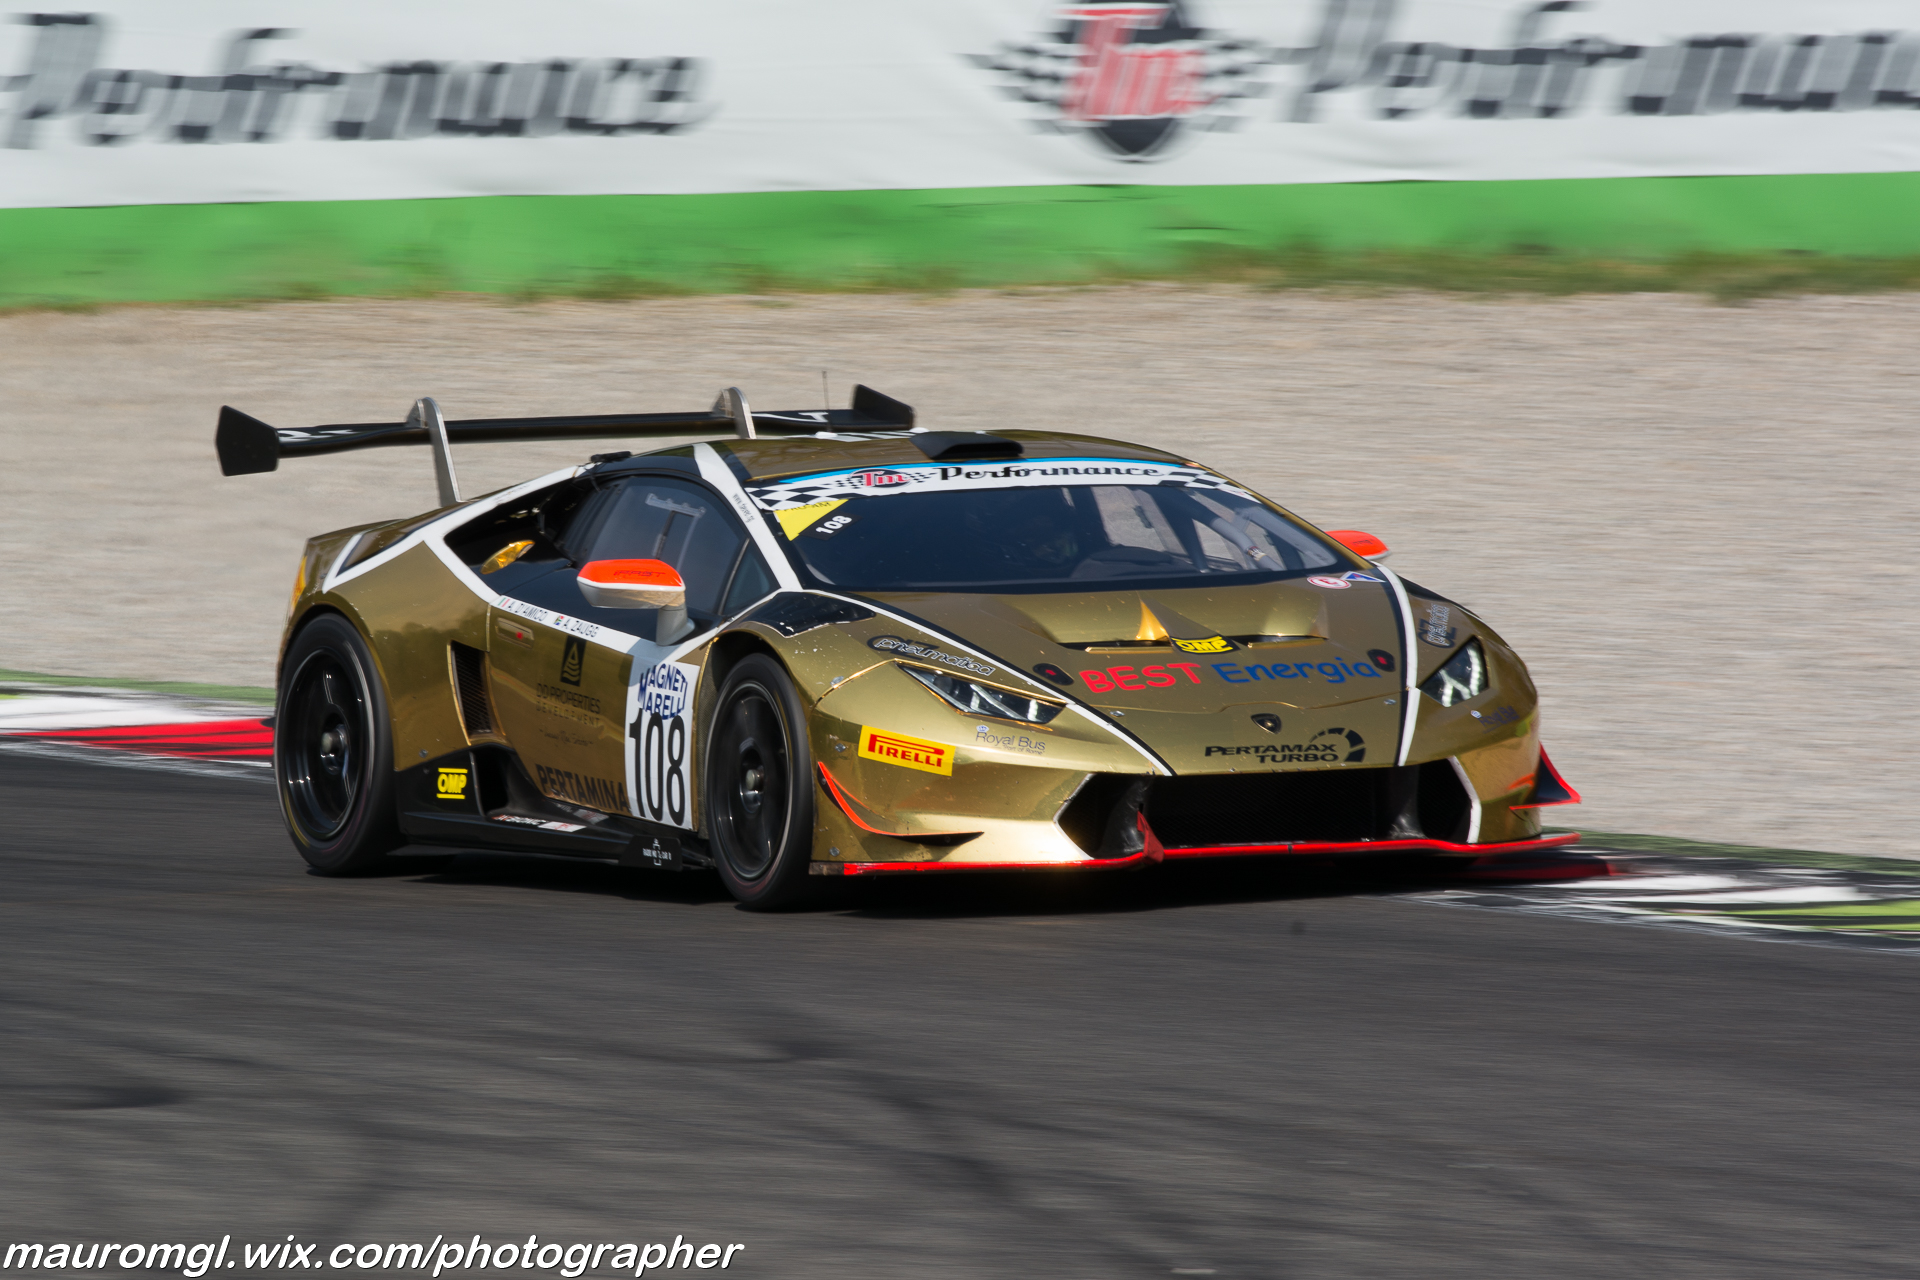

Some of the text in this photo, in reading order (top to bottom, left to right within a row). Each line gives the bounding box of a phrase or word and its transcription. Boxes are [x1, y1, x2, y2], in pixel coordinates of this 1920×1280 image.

[938, 465, 1161, 481] Performance
[815, 515, 852, 534] 108
[1178, 638, 1234, 652] OMP
[874, 639, 996, 676] pneumatica
[1079, 657, 1382, 693] BEST Energia
[550, 685, 601, 714] PROPERTIES
[867, 733, 945, 768] PIRELLI
[976, 731, 1046, 751] Royal Bus
[1204, 743, 1337, 757] PERTAMAX
[629, 708, 686, 826] 108
[1259, 753, 1339, 764] TURBO
[437, 771, 468, 795] OMP
[535, 763, 632, 813] PERTAMINA
